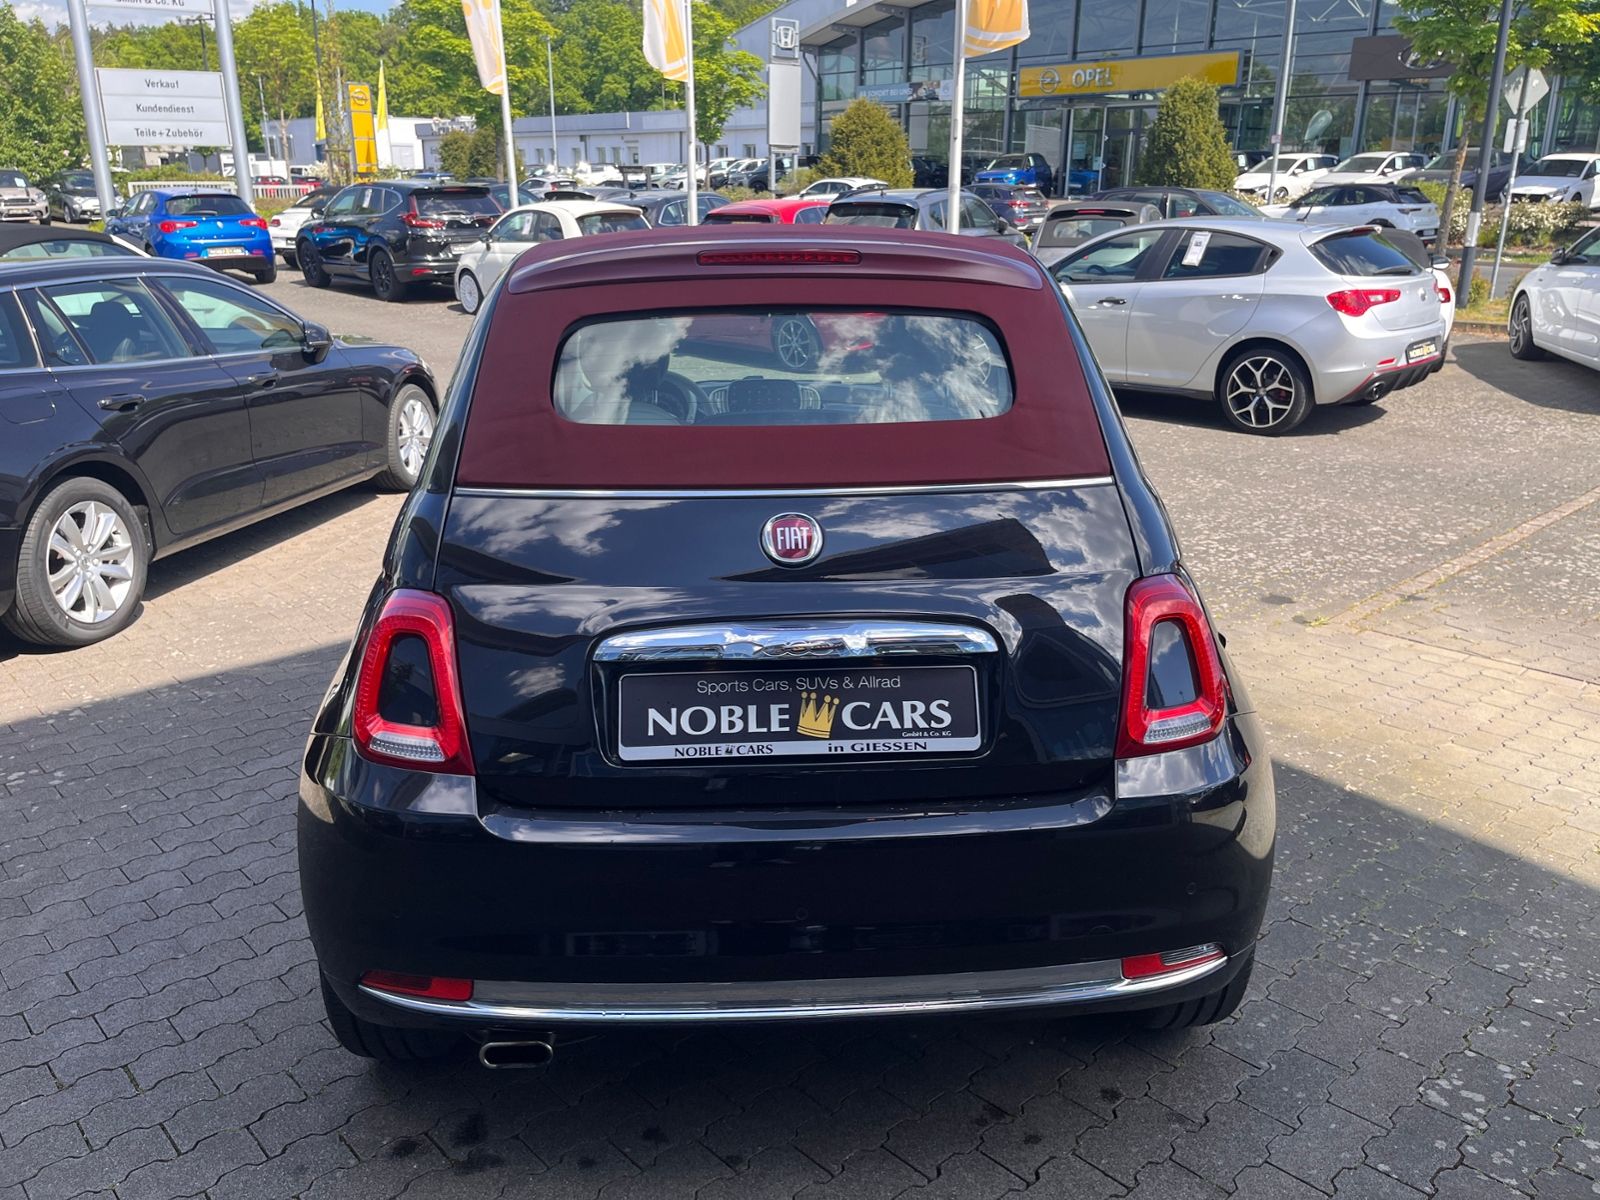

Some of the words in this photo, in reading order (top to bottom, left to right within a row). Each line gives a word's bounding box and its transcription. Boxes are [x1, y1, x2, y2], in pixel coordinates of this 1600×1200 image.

[145, 79, 180, 89] Verkauf
[1072, 68, 1114, 88] OPEL
[136, 104, 195, 114] Kundendienst
[776, 527, 809, 550] FIAT
[697, 680, 749, 696] Sports
[752, 678, 793, 693] Cars,
[796, 676, 839, 691] SUVs
[842, 676, 854, 690] &
[857, 675, 901, 689] Allrad
[647, 704, 790, 736] NOBLE
[841, 699, 952, 730] CARS
[674, 746, 722, 757] NOBLE
[736, 744, 774, 755] CARS
[827, 743, 844, 752] in
[850, 741, 927, 752] GIESSEN
